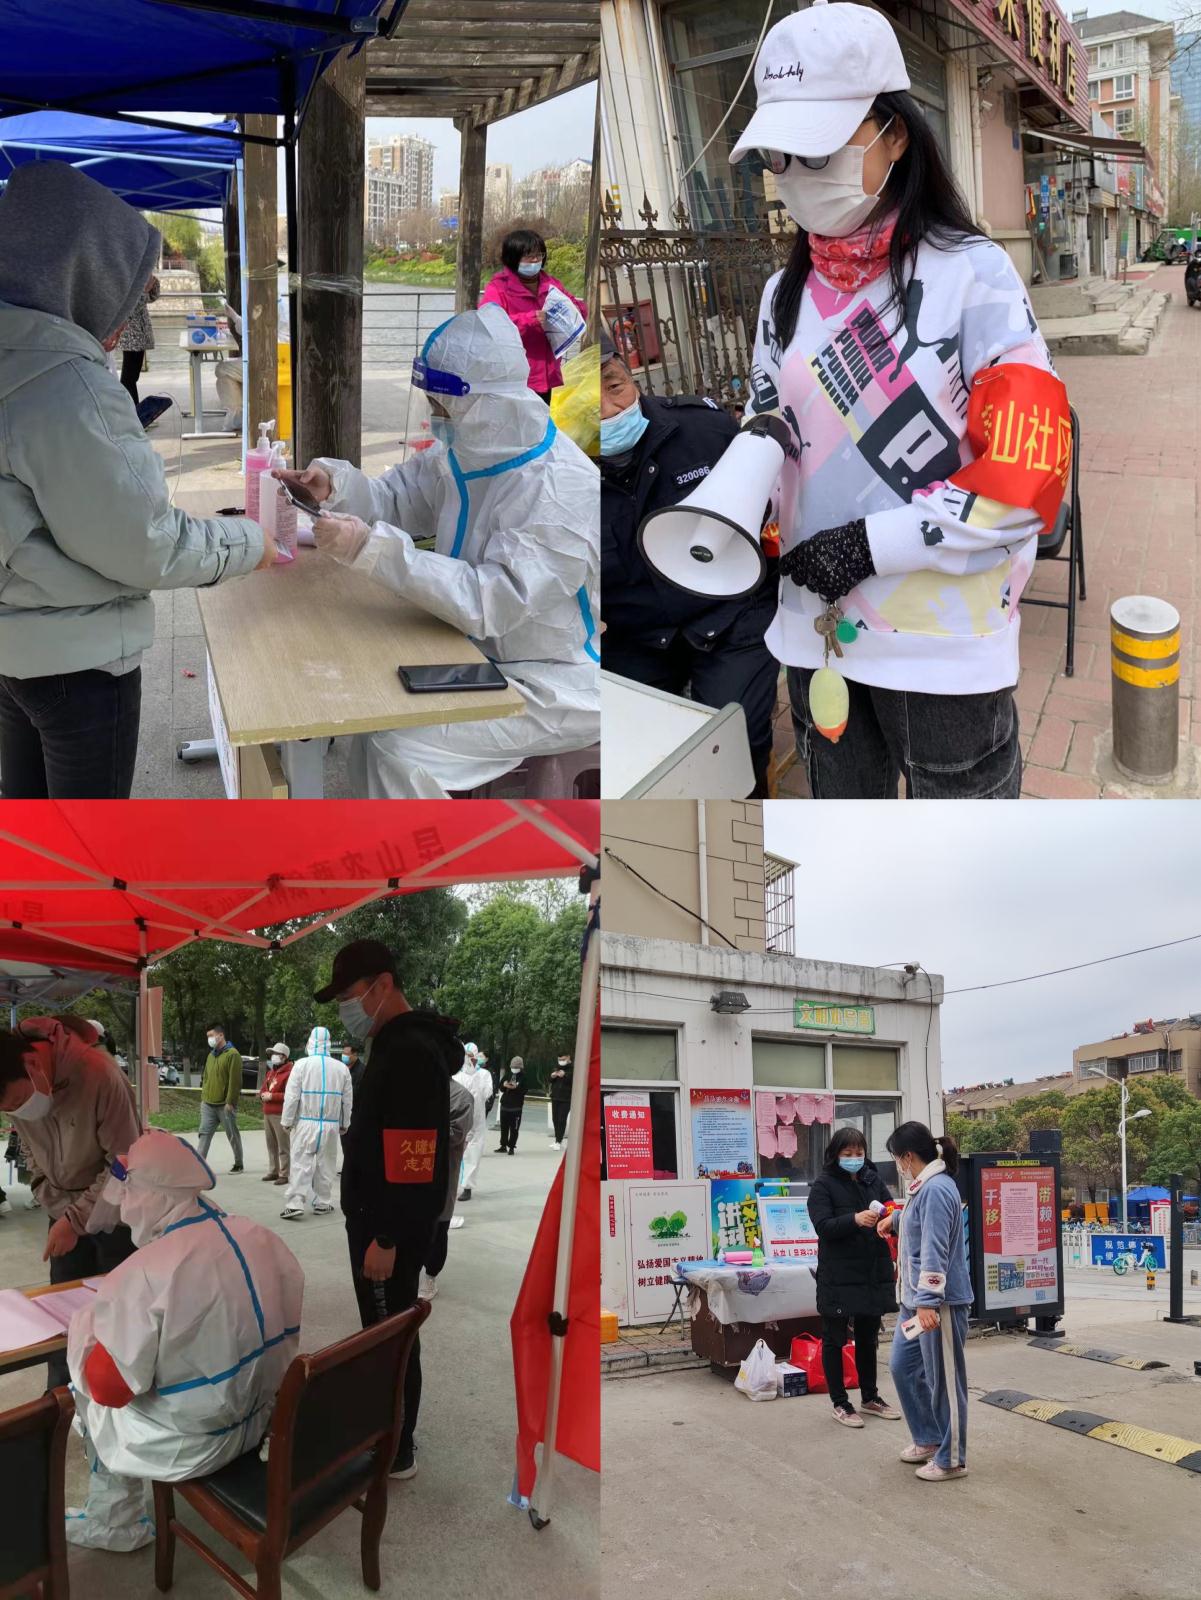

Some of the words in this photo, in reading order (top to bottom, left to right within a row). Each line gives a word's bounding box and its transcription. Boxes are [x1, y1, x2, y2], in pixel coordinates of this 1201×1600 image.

[850, 306, 896, 374] PUMA
[981, 400, 1072, 487] 山社区
[611, 1110, 645, 1119] 收费通知
